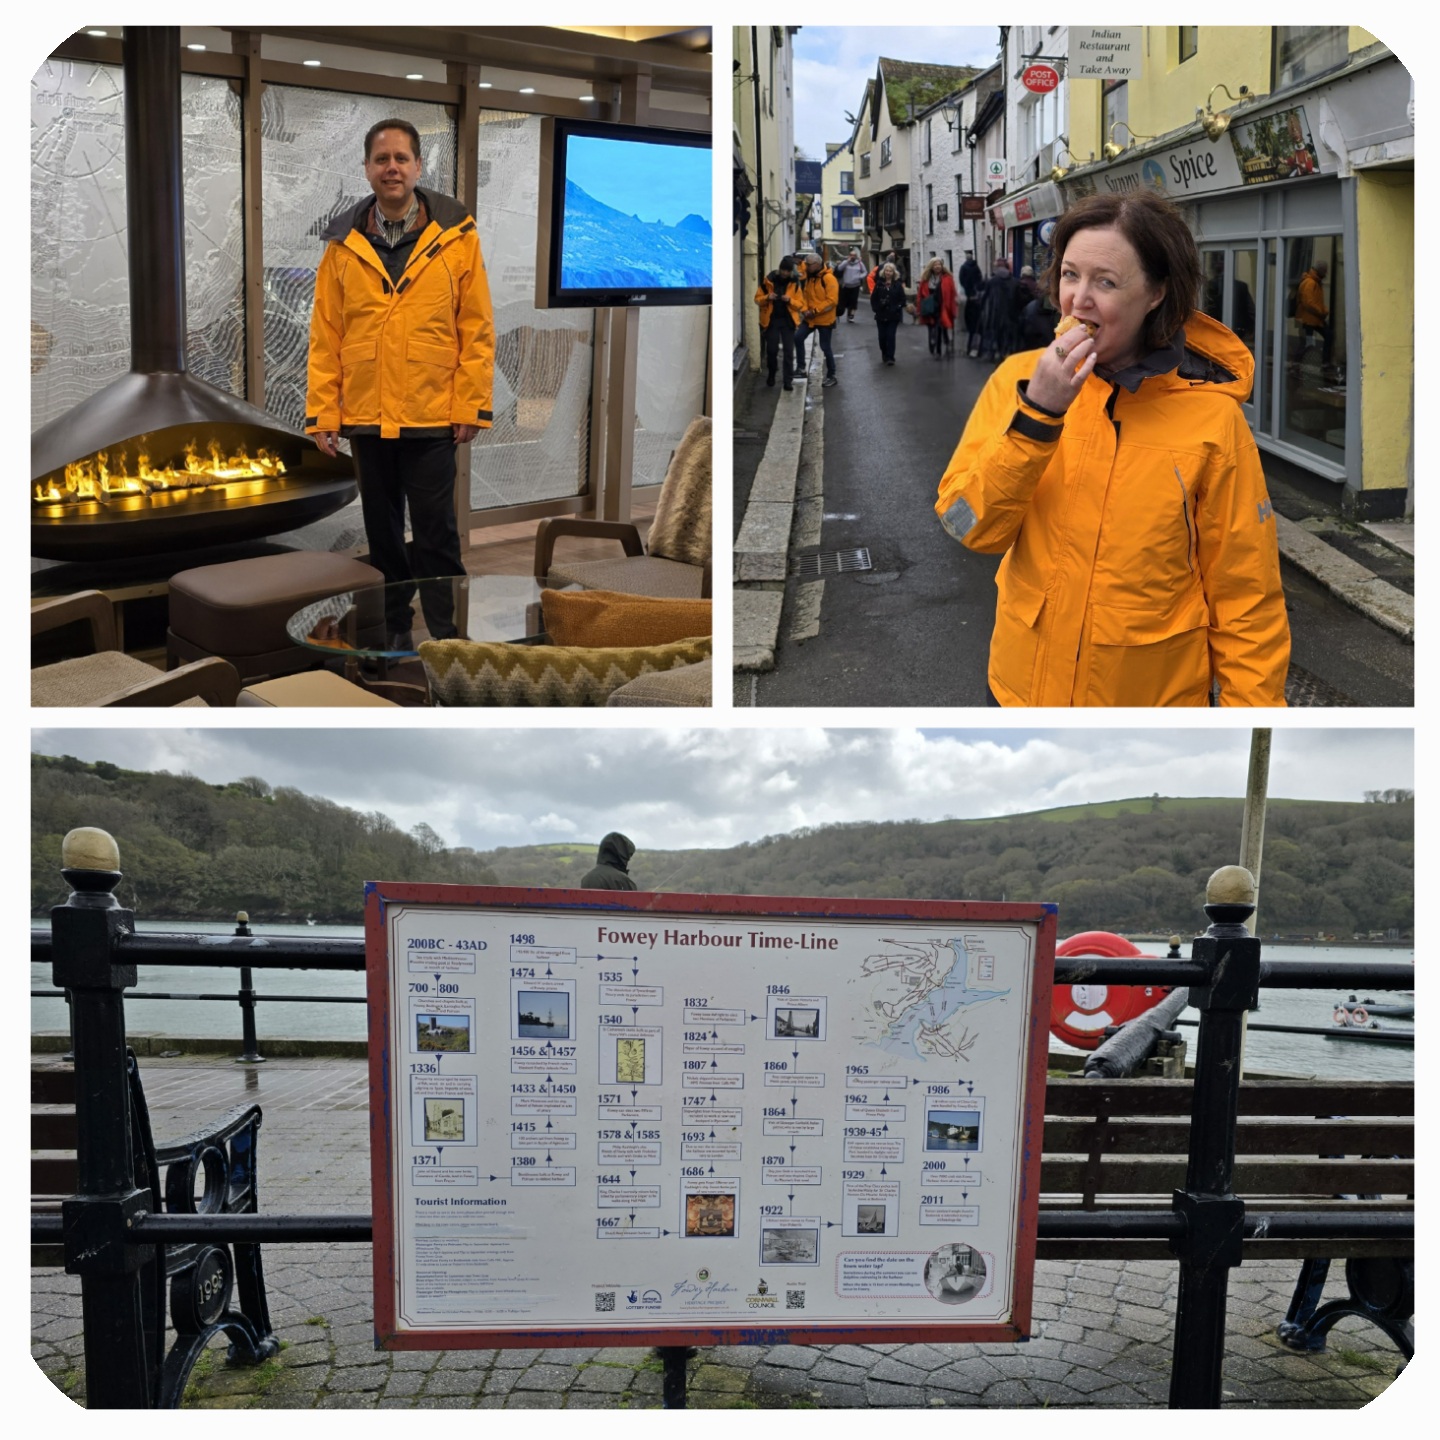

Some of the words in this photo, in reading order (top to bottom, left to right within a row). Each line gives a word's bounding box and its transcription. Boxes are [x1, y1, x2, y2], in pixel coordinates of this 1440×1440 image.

[1091, 29, 1121, 39] Indian
[1080, 41, 1130, 51] Restaurant
[1096, 54, 1114, 62] and
[1080, 65, 1102, 74] Take
[1104, 66, 1131, 76] Away
[1025, 79, 1054, 87] OFFICE
[1169, 149, 1218, 189] Spice
[510, 934, 535, 944] 1498
[598, 926, 658, 950] Fowey
[663, 929, 742, 948] Harbour
[747, 931, 839, 950] Time-Line
[407, 938, 445, 950] 200BC
[456, 940, 487, 951] 43AD
[510, 968, 535, 978] 1474
[598, 972, 622, 982] 1535
[408, 983, 429, 993] 700
[439, 984, 459, 994] 800
[766, 985, 790, 995] 1846
[683, 998, 708, 1008] 1832
[598, 1015, 622, 1025] 1540
[683, 1031, 707, 1042] 1824
[511, 1046, 536, 1056] 1456
[538, 1047, 547, 1056] &
[552, 1047, 577, 1057] 1457
[410, 1063, 437, 1073] 1336
[683, 1061, 707, 1070] 1807
[764, 1061, 788, 1070] 1860
[845, 1065, 869, 1075] 1965
[511, 1084, 536, 1094] 1433
[538, 1085, 547, 1094] &
[551, 1084, 577, 1094] 1450
[926, 1085, 950, 1095] 1986
[598, 1094, 621, 1104] 1571
[682, 1096, 706, 1106] 1747
[844, 1094, 868, 1104] 1962
[763, 1107, 786, 1116] 1864
[511, 1122, 536, 1132] 1415
[597, 1130, 621, 1139] 1578
[624, 1131, 633, 1139] &
[637, 1130, 660, 1139] 1585
[681, 1132, 705, 1142] 1693
[412, 1155, 437, 1165] 1371
[511, 1157, 536, 1166] 1380
[761, 1156, 785, 1165] 1870
[922, 1161, 946, 1170] 2000
[681, 1167, 704, 1176] 1686
[841, 1170, 865, 1179] 1929
[597, 1175, 621, 1184] 1644
[414, 1197, 448, 1206] Tourist
[450, 1197, 507, 1206] Information
[921, 1196, 944, 1205] 2011
[759, 1205, 783, 1215] 1922
[596, 1218, 620, 1227] 1667
